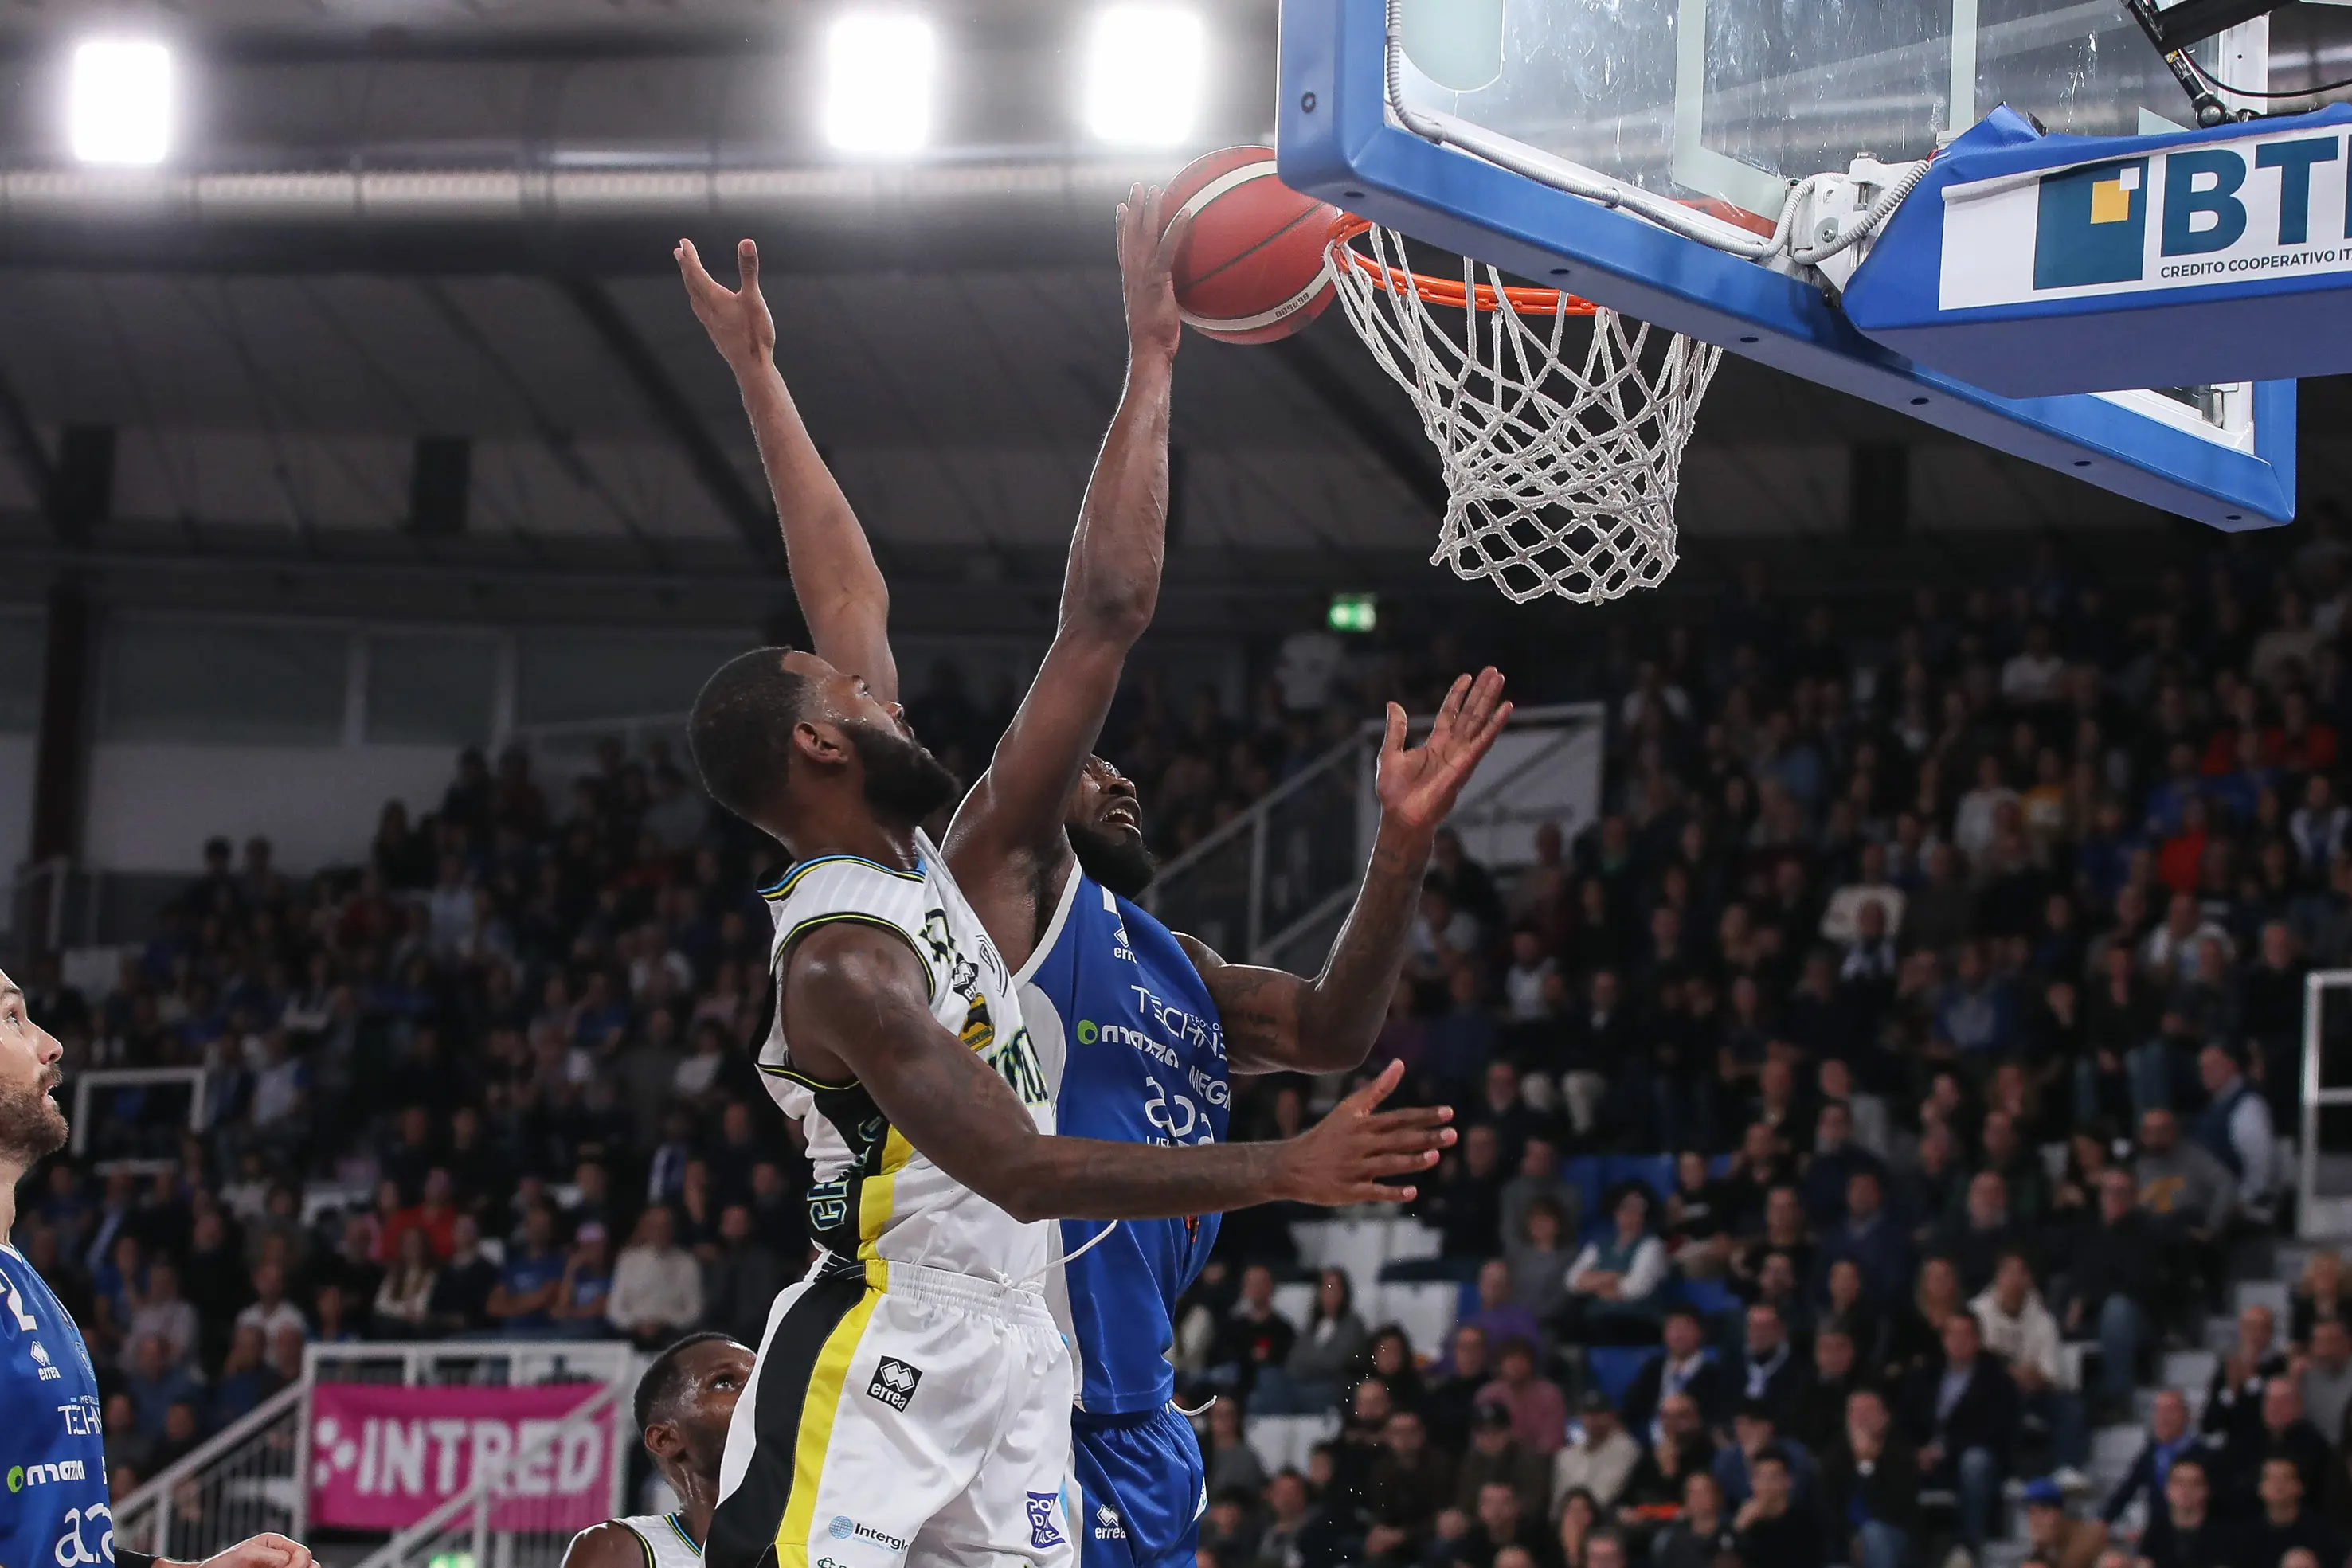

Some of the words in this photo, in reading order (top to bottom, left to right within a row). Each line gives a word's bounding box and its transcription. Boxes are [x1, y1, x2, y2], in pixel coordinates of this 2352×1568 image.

[2160, 261, 2225, 279] CREDITO
[2228, 249, 2335, 272] COOPERATIVO
[356, 1418, 602, 1496] INTRED
